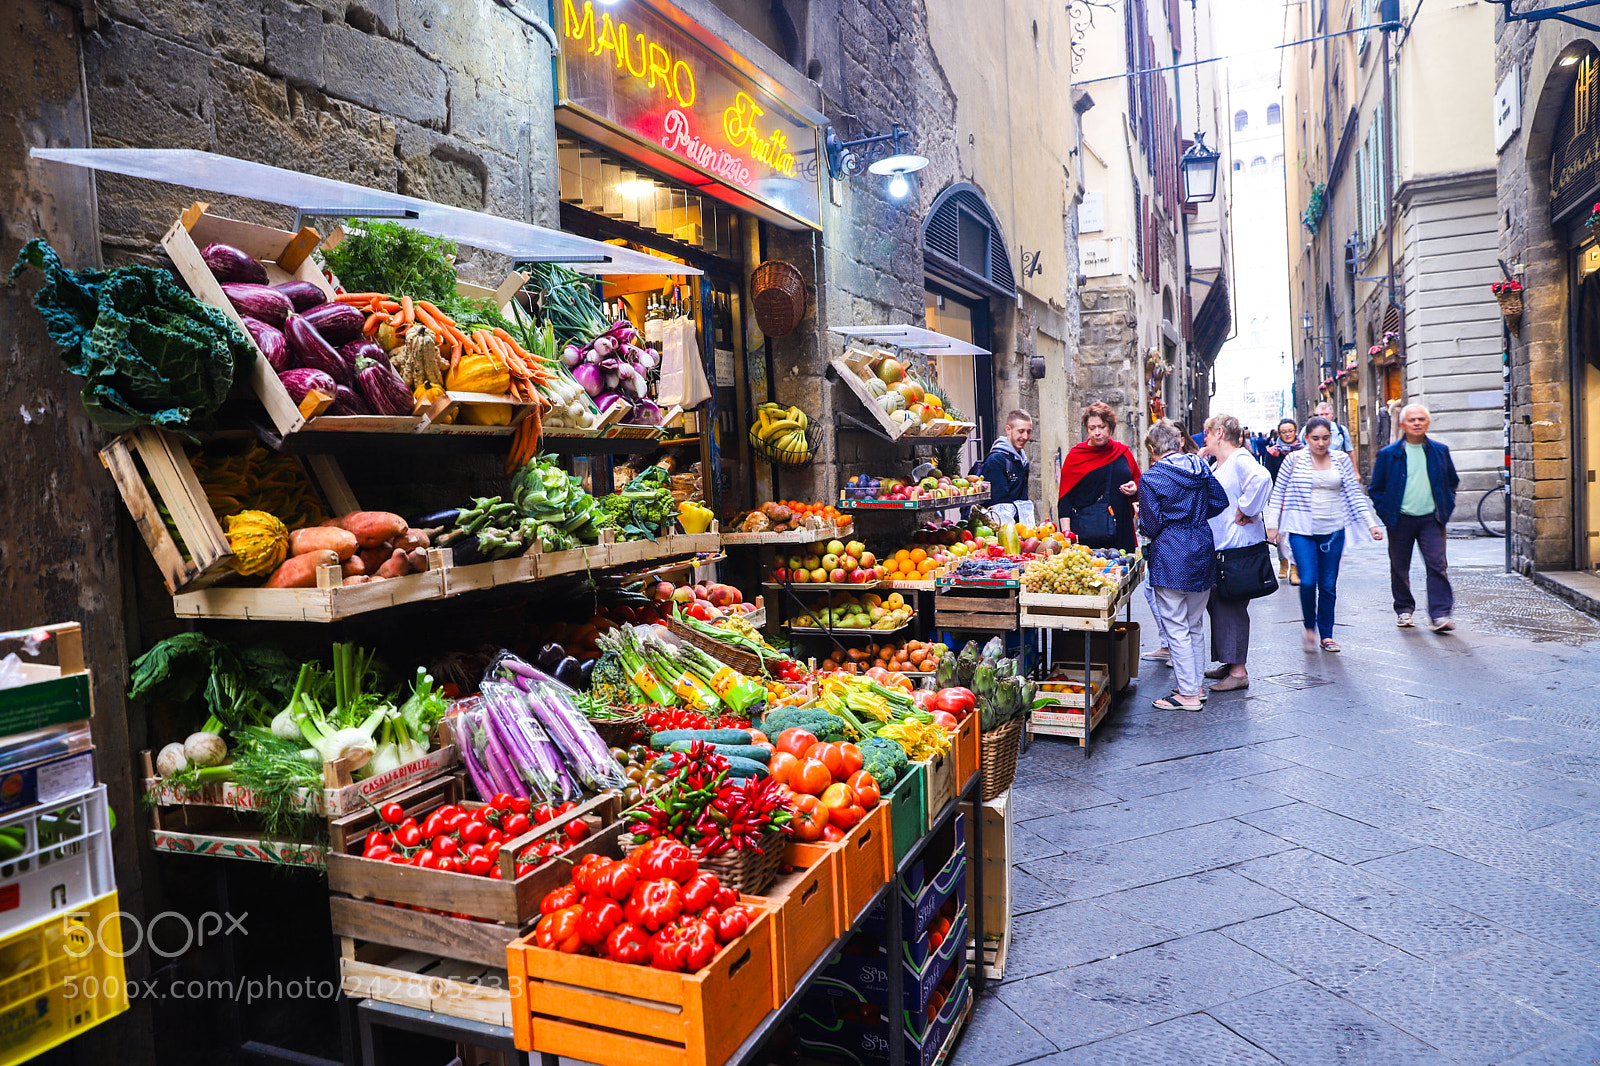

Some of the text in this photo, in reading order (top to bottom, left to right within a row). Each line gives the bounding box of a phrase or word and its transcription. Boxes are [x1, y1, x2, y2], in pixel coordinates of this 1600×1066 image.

[563, 0, 696, 108] MAURO
[661, 109, 751, 187] Primizie
[723, 90, 798, 178] Frutta
